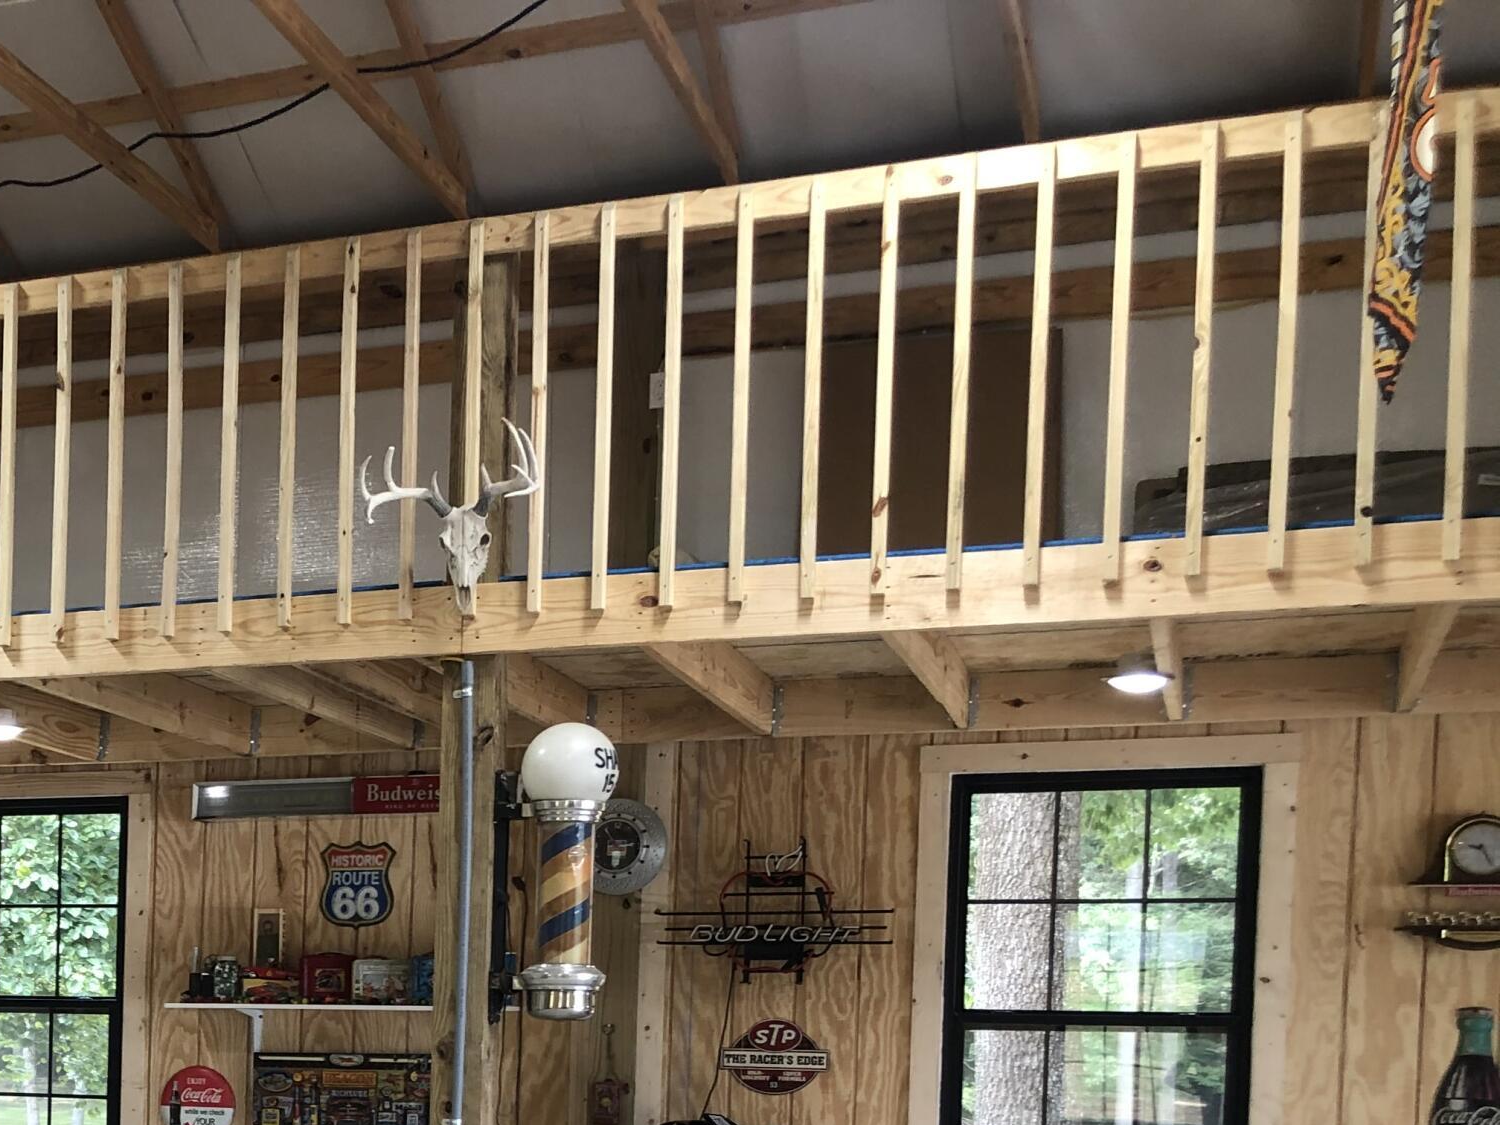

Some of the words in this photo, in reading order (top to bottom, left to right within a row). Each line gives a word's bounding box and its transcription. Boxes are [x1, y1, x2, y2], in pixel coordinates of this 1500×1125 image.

[594, 747, 618, 771] SH
[331, 855, 384, 867] HISTORIC
[332, 871, 380, 886] ROUTE
[331, 886, 380, 920] 66
[691, 924, 758, 943] BUD
[763, 923, 860, 943] LIGHT
[754, 1023, 797, 1047] STP
[724, 1053, 747, 1065] THE
[749, 1054, 794, 1066] RACER'S
[797, 1055, 825, 1066] EDGE
[181, 1087, 225, 1104] Coca-Cola
[195, 1117, 216, 1125] YOUR
